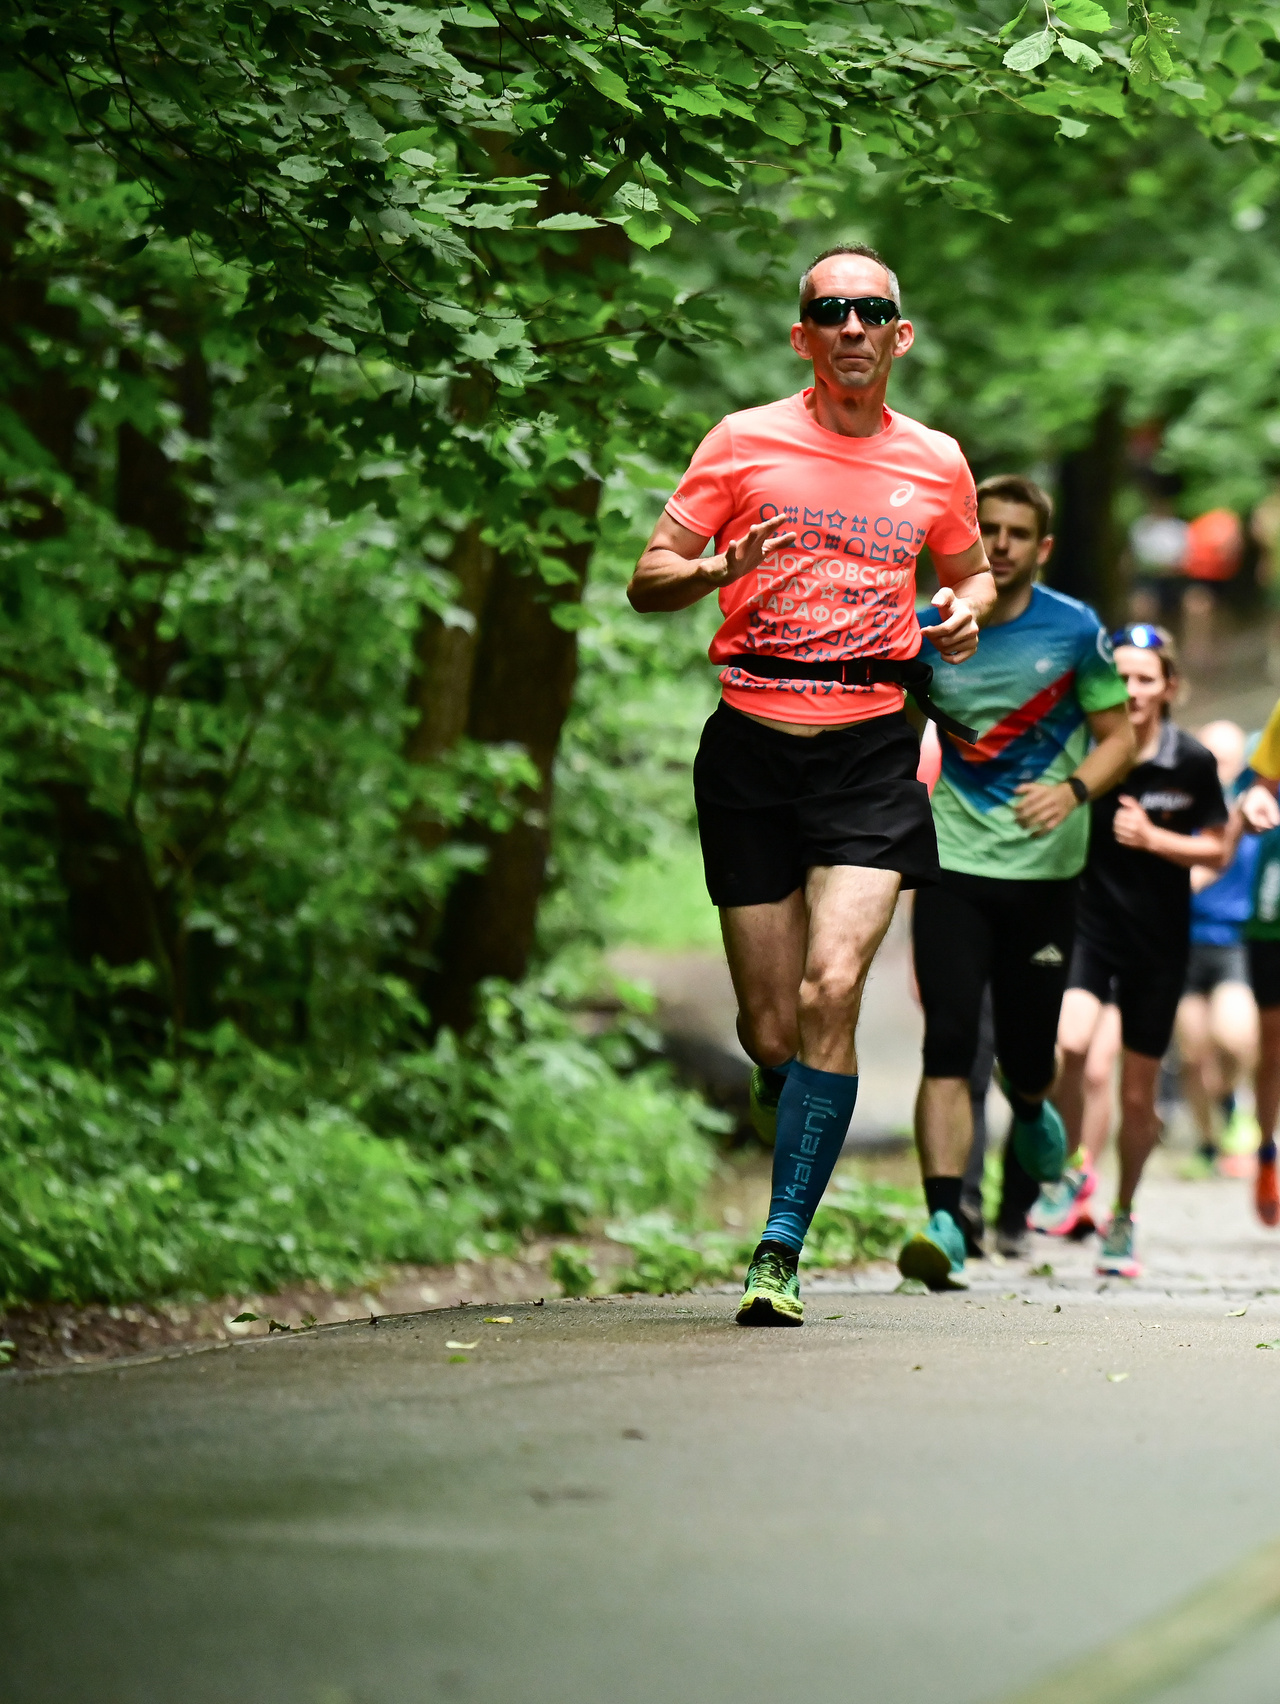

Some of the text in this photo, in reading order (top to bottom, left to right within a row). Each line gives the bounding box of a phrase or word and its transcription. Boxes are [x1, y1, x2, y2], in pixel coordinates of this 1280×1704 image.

[757, 573, 820, 598] ПОЛУ
[747, 594, 868, 627] МАРАФОН
[783, 1094, 838, 1204] kalenji
